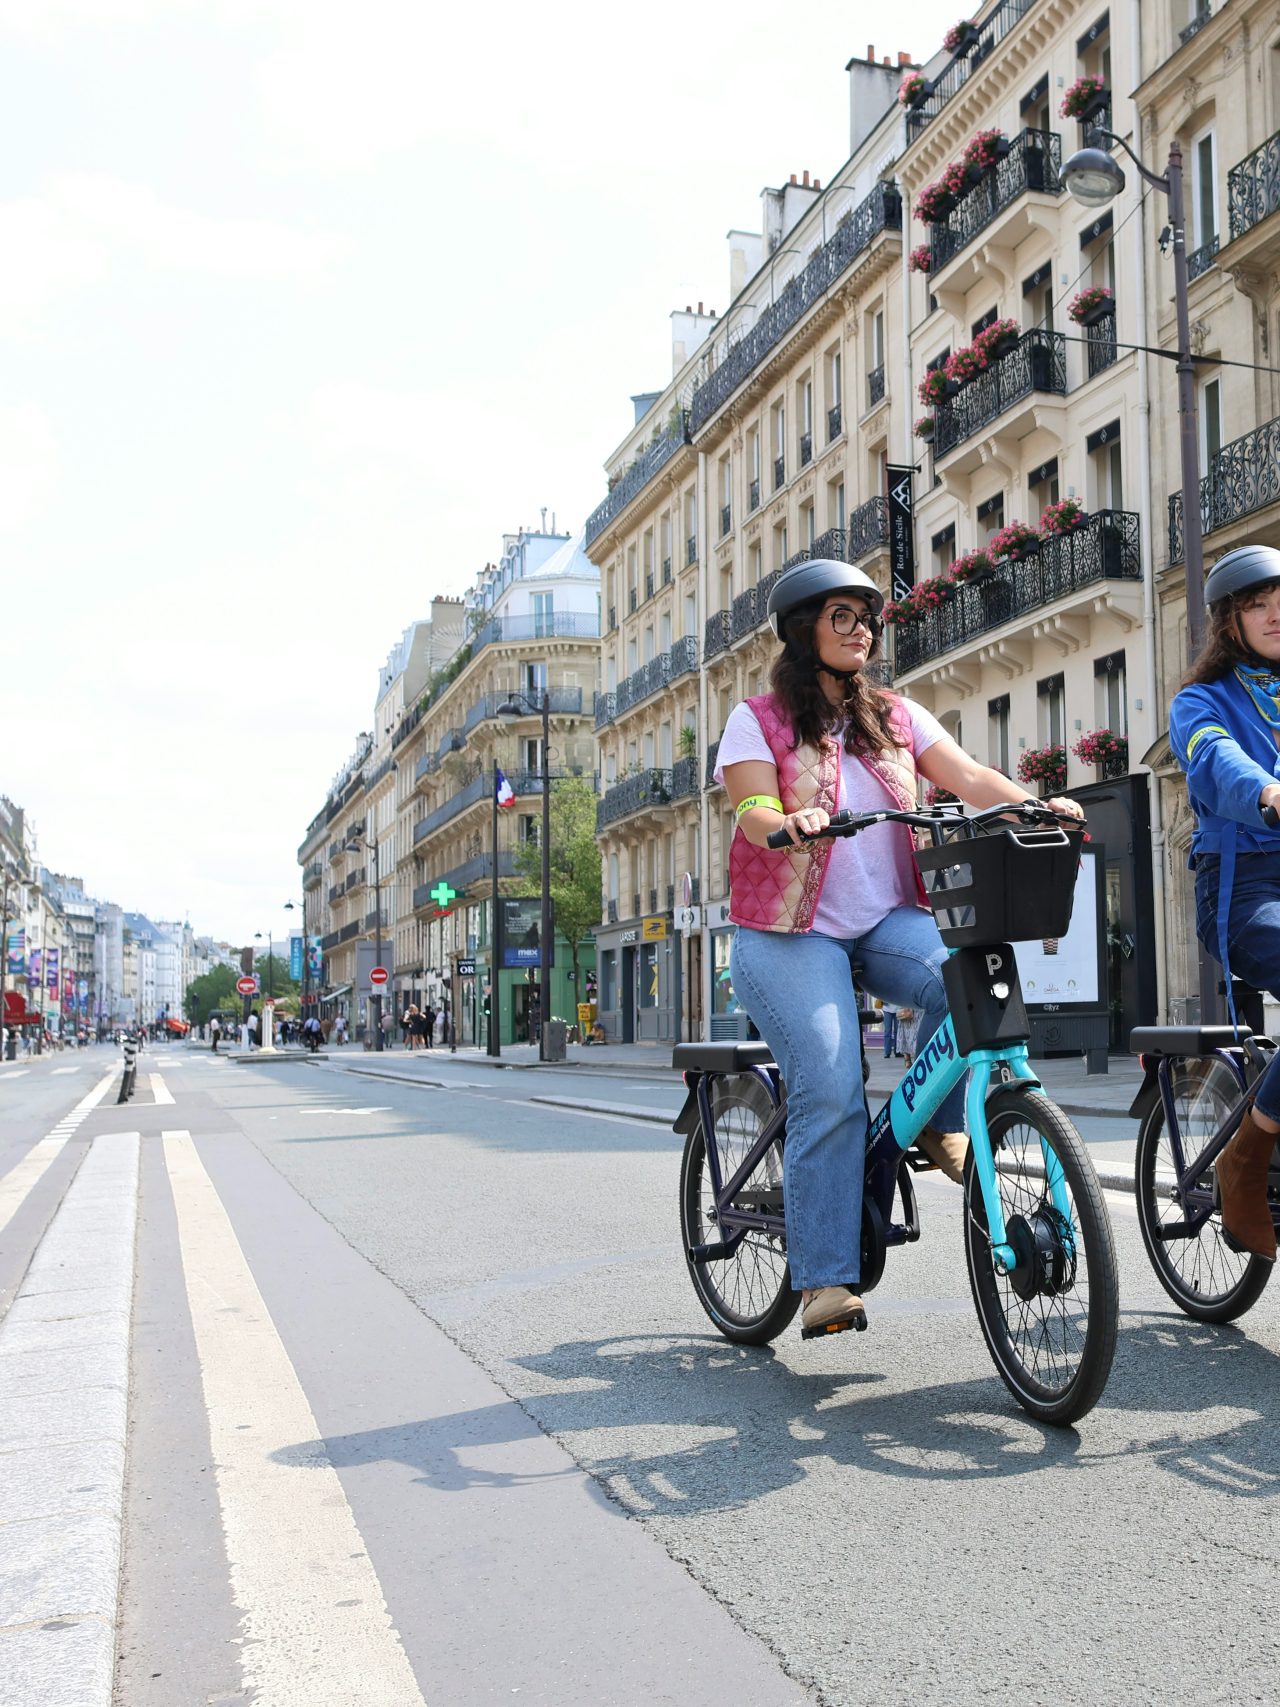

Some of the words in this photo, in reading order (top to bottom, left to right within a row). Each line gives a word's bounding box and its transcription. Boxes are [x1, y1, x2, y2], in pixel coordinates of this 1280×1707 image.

[739, 798, 757, 812] ony
[460, 965, 475, 975] OR
[985, 953, 1003, 976] P
[901, 1023, 955, 1113] pony
